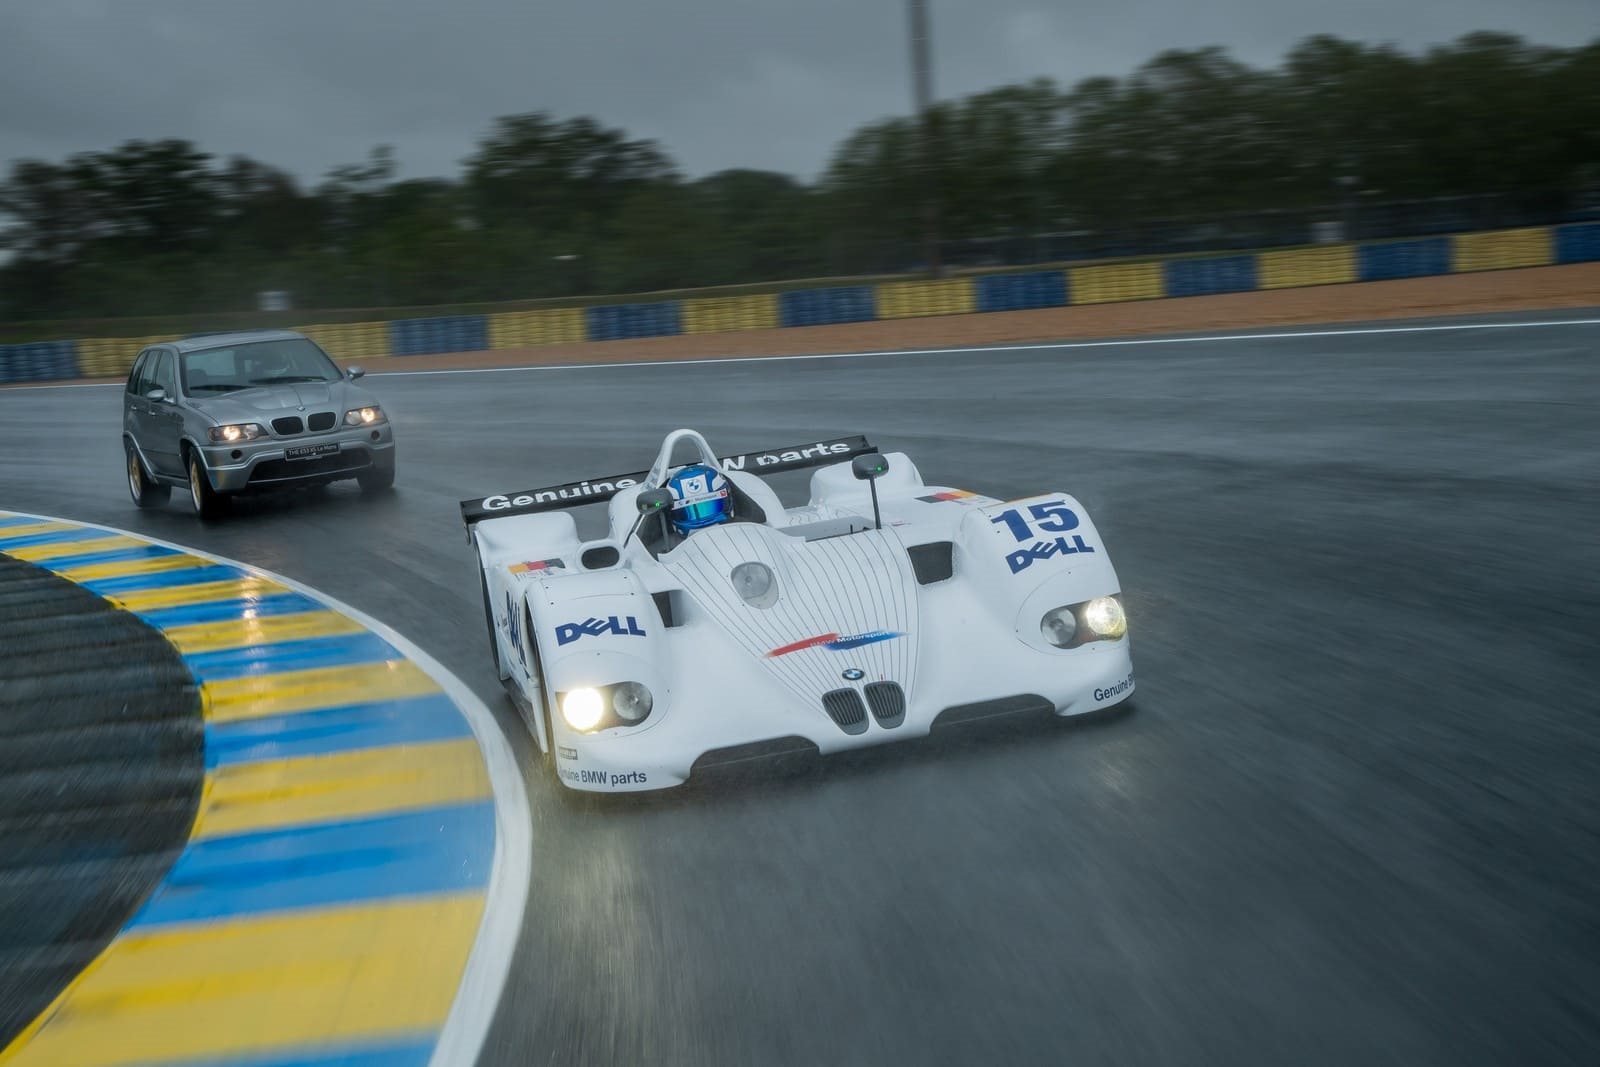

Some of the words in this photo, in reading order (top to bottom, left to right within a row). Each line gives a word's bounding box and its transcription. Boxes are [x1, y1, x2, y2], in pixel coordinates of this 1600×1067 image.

[482, 478, 637, 511] Genuine
[756, 443, 850, 466] parts
[991, 500, 1079, 542] 15
[1005, 535, 1095, 575] DELL
[555, 616, 646, 647] DELL
[1094, 680, 1128, 701] Genuine
[581, 770, 607, 784] BMW
[611, 771, 647, 787] parts
